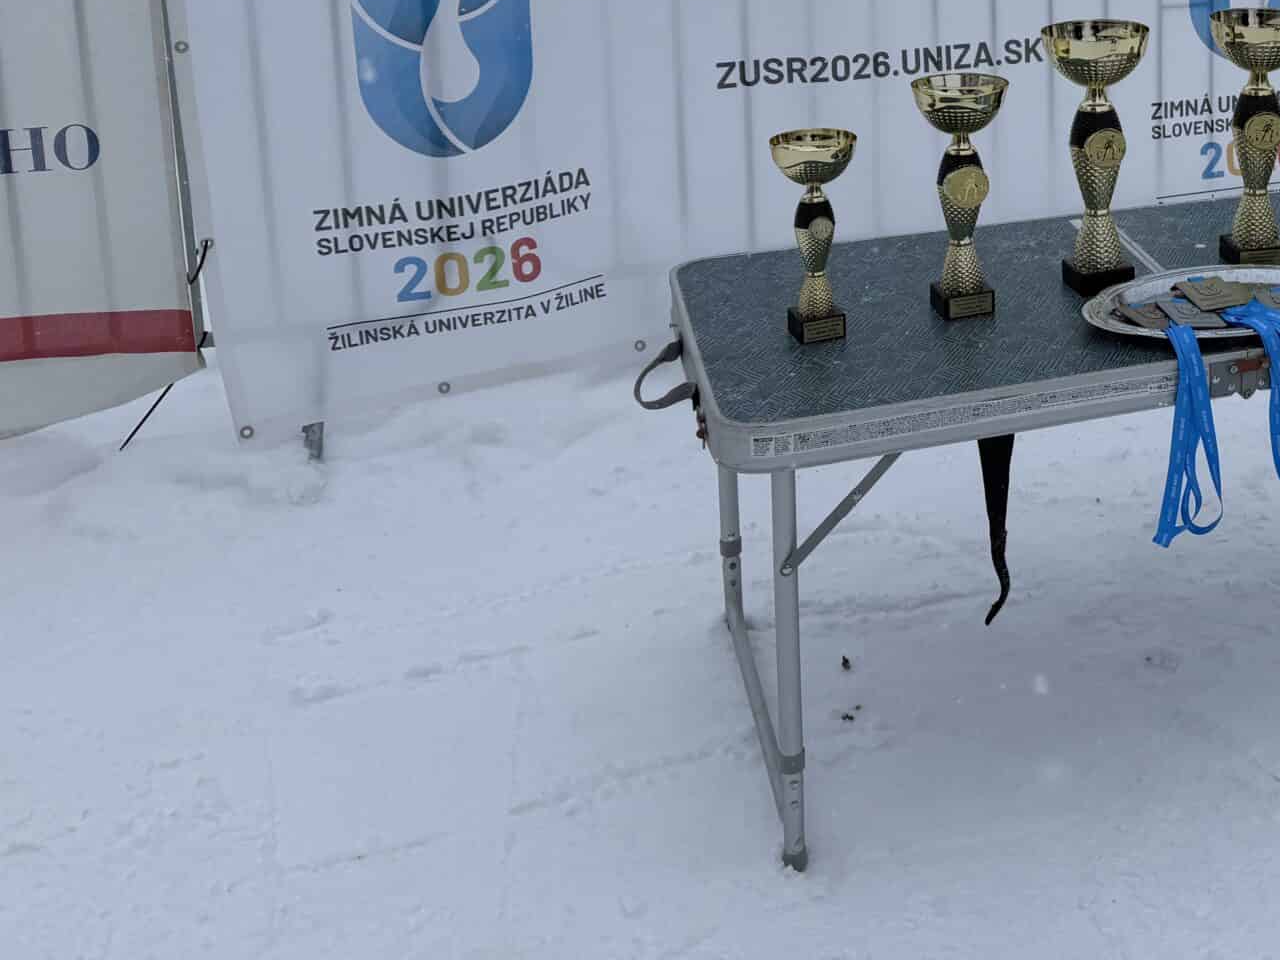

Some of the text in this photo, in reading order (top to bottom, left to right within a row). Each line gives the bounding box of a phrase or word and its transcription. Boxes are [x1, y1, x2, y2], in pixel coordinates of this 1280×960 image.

[716, 38, 1044, 89] ZUSR2026.UNIZA.SK
[1151, 93, 1213, 120] ZIMNÁ
[313, 167, 591, 232] ZIMNÁ UNIVERZIÁDA
[316, 192, 592, 256] SLOVENSKEJ REPUBLIKY
[393, 236, 542, 303] 2026
[328, 283, 607, 351] ŽILINSKÁ UNIVERZITA V ŽILINE
